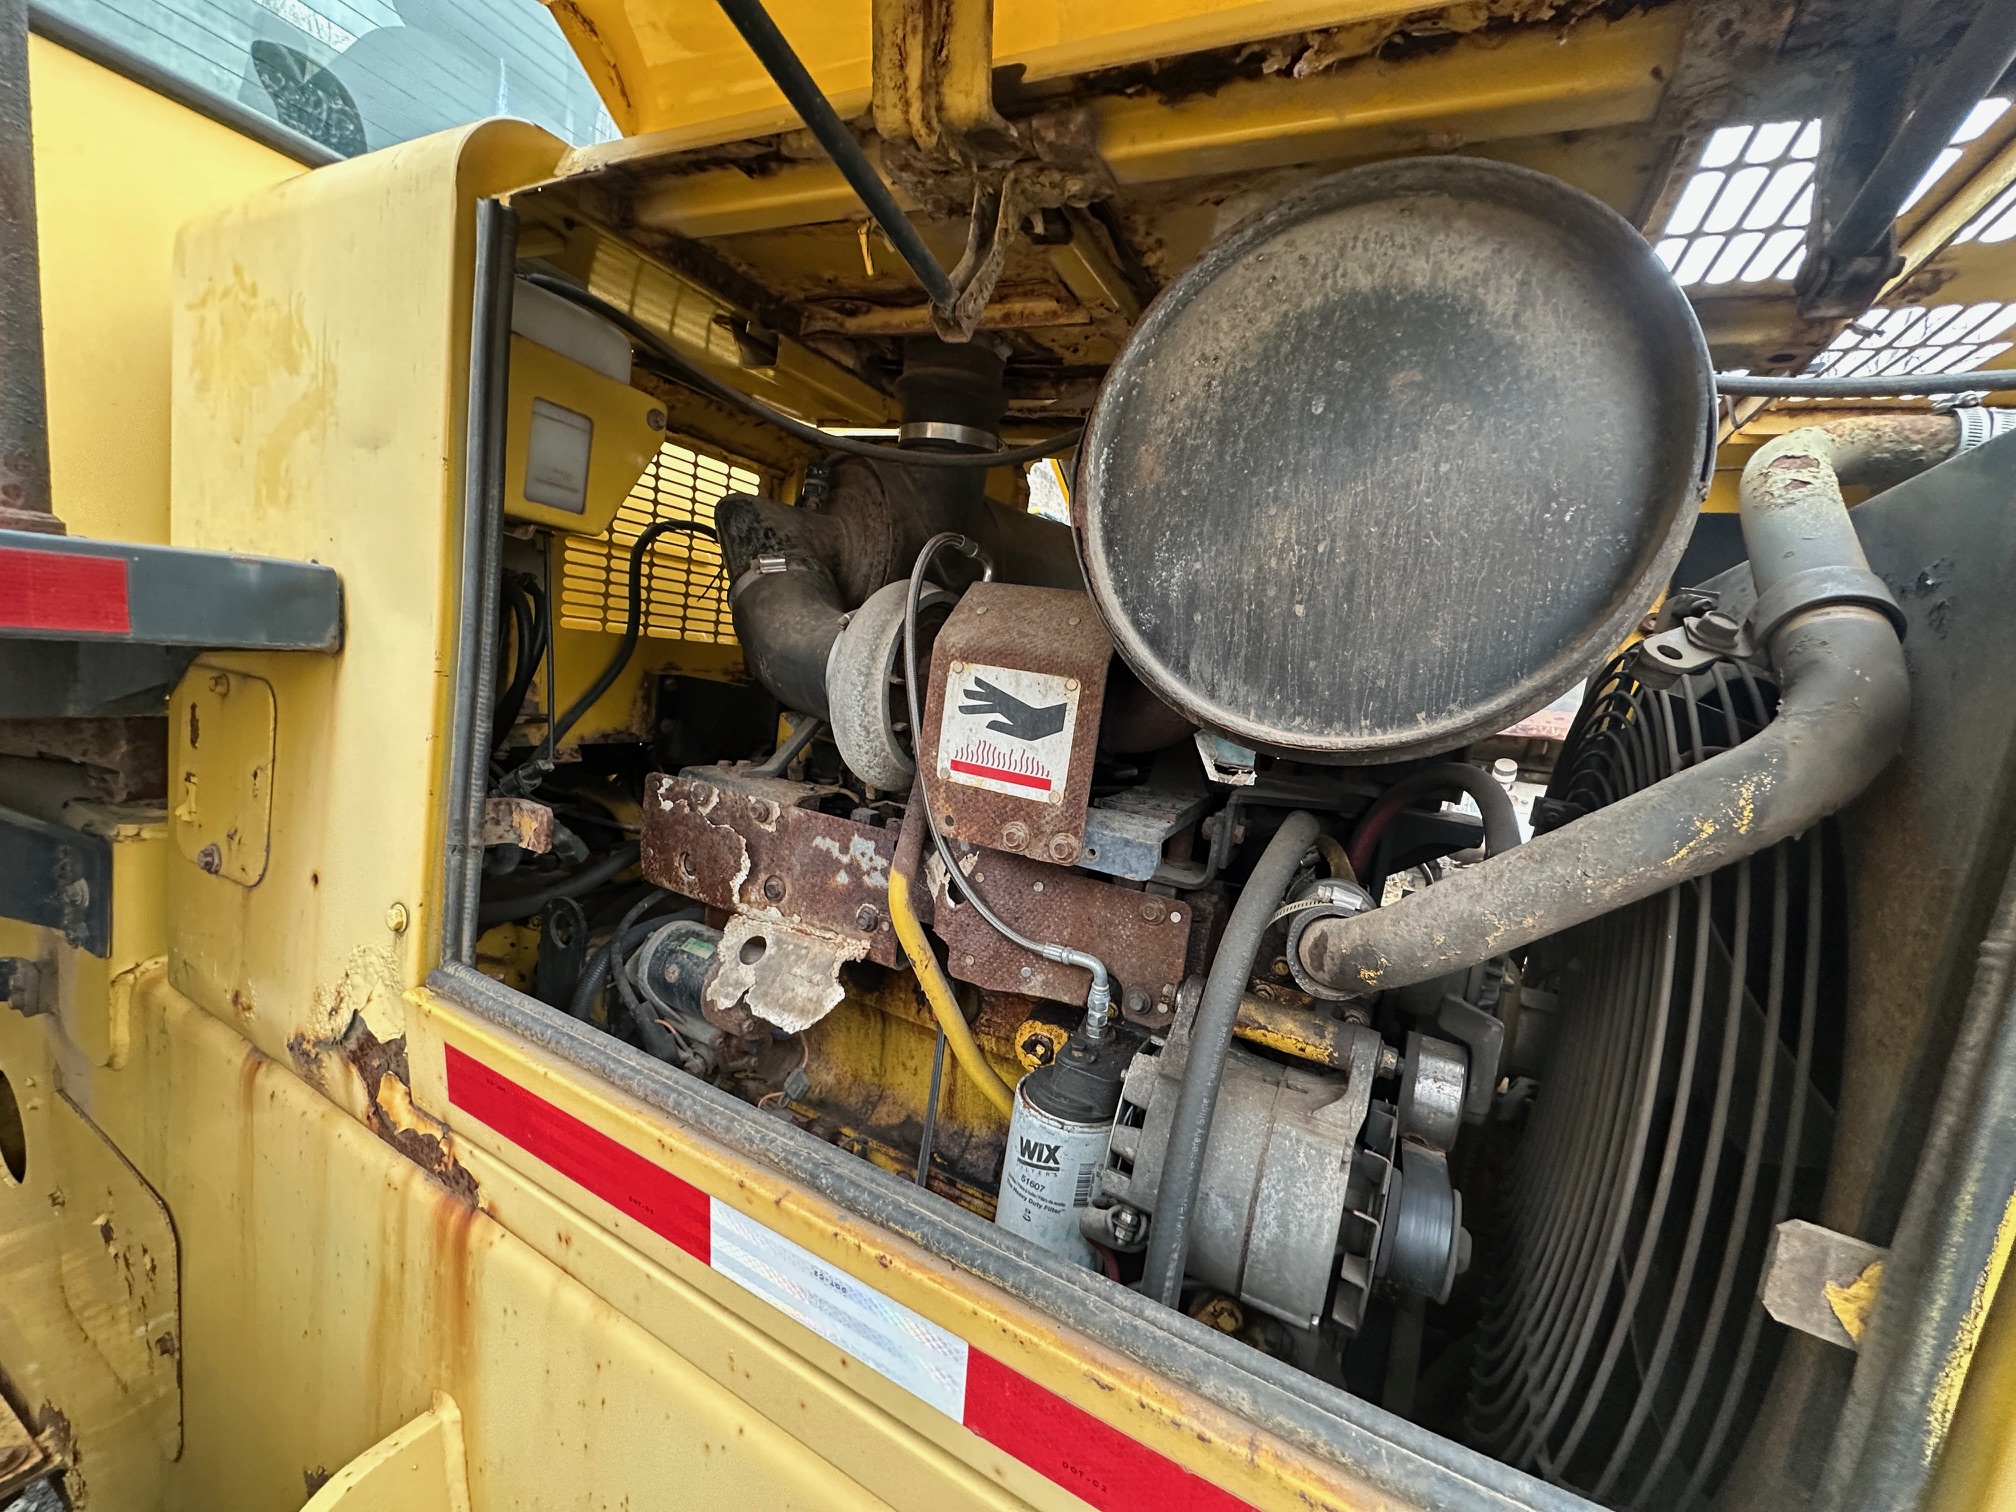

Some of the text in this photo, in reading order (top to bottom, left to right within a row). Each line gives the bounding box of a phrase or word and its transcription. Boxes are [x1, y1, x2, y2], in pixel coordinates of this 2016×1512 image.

[1020, 1135, 1060, 1165] WIX
[1020, 1174, 1046, 1192] 51607
[1013, 1186, 1027, 1202] Heavy
[1028, 1198, 1043, 1210] Duty
[813, 1270, 847, 1294] DOT-C2
[1062, 1461, 1107, 1493] DOT-C2
